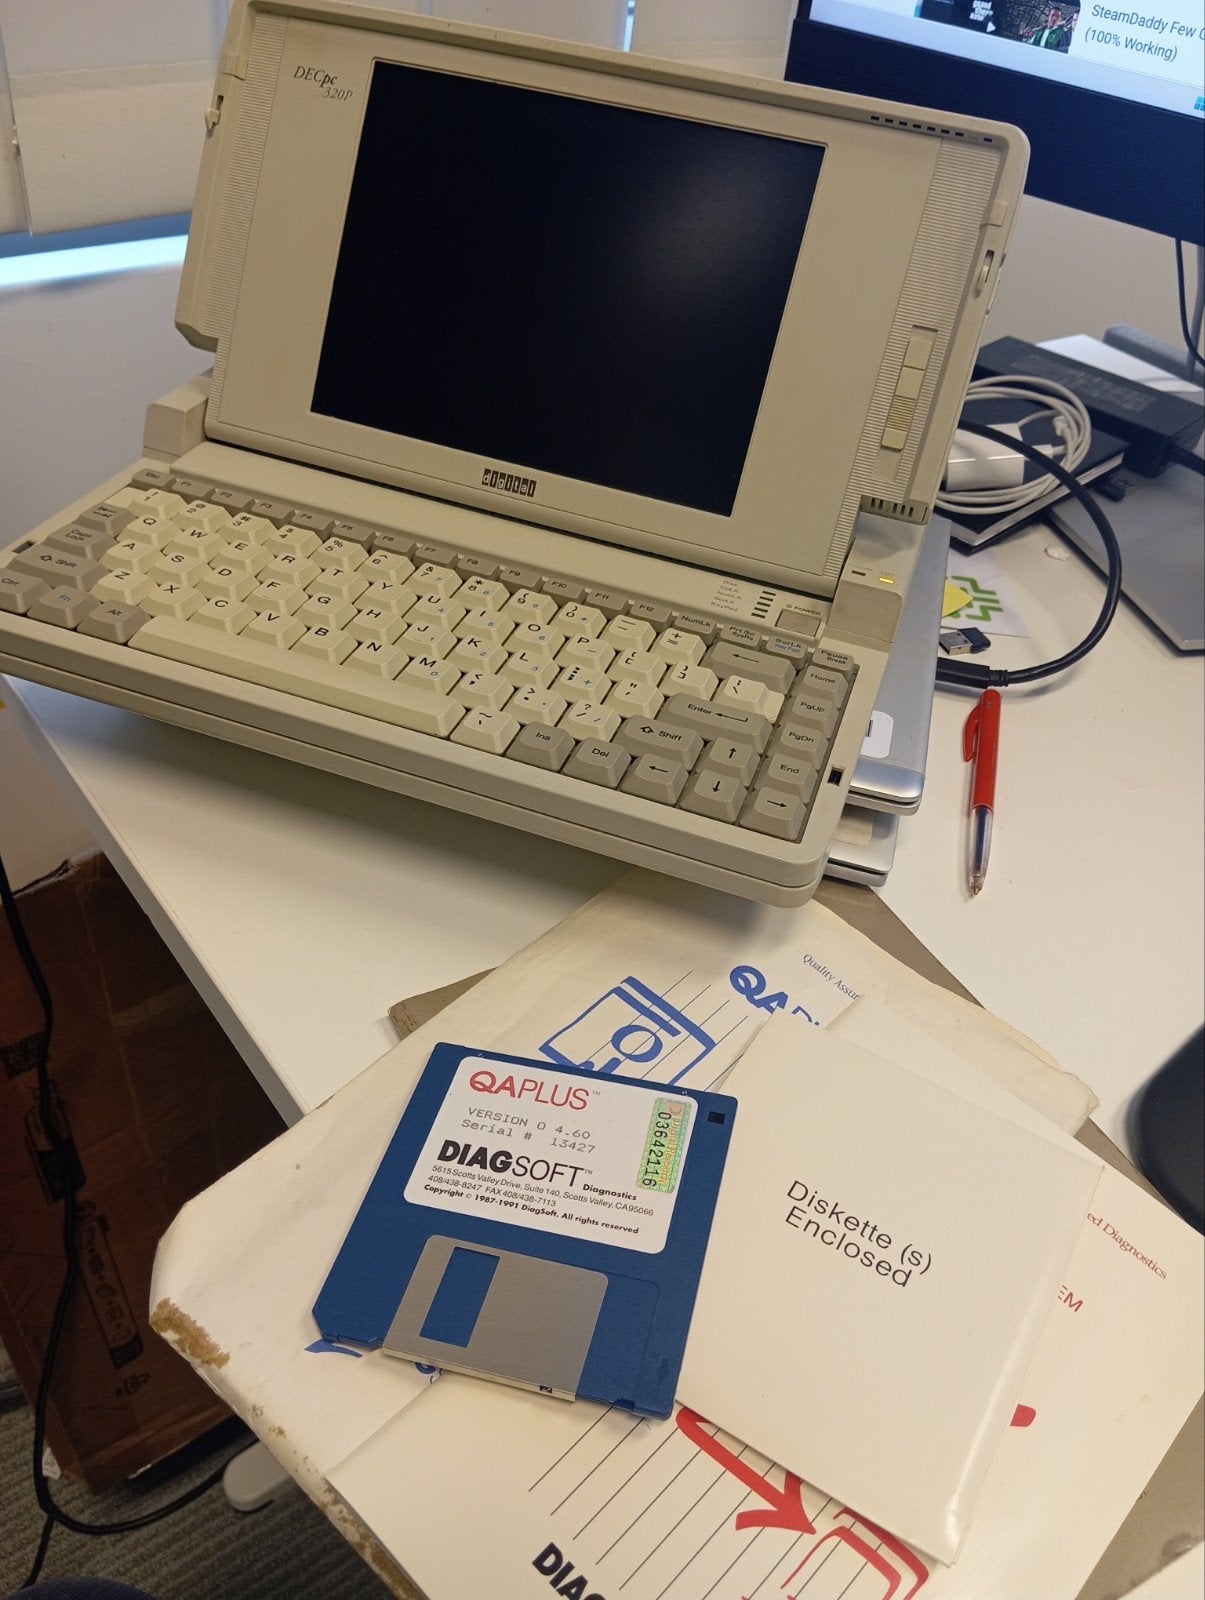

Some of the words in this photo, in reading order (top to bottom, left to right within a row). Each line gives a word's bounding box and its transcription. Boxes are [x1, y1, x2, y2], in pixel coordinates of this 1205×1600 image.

[1091, 4, 1169, 34] SteamDaddy
[1170, 21, 1197, 38] Few
[1085, 27, 1121, 47] (100%
[1124, 36, 1178, 62] Working)
[293, 65, 338, 88] DECpc
[322, 86, 353, 101] 320P
[482, 468, 538, 498] digital
[143, 517, 157, 526] Q
[190, 530, 208, 539] W
[122, 542, 136, 551] A
[234, 542, 248, 551] E
[55, 558, 78, 568] Shift
[171, 555, 185, 564] S
[281, 555, 296, 564] R
[114, 571, 130, 580] Z
[218, 568, 232, 577] D
[332, 568, 344, 576] T
[1, 577, 20, 587] Ctrl
[267, 581, 281, 590] F
[381, 582, 394, 590] Y
[552, 581, 568, 589] F10
[164, 584, 180, 594] X
[214, 600, 229, 608] C
[317, 596, 331, 605] G
[428, 596, 441, 604] U
[108, 608, 123, 616] Alt
[640, 604, 655, 612] F12
[267, 612, 280, 622] V
[366, 609, 382, 619] H
[314, 627, 329, 637] B
[417, 625, 429, 634] J
[528, 623, 541, 632] O
[468, 638, 482, 648] K
[577, 636, 590, 645] P
[366, 641, 382, 652] N
[519, 652, 529, 662] L
[418, 657, 438, 668] M
[810, 673, 836, 684] Home
[688, 704, 714, 716] Enter
[800, 702, 826, 714] PgUp
[536, 732, 550, 742] Ins
[658, 730, 682, 742] Shift
[788, 732, 815, 744] PgDn
[592, 748, 610, 758] Del
[780, 764, 800, 774] End
[803, 954, 835, 982] Quality
[469, 1070, 590, 1111] QAPLUS
[468, 1106, 529, 1127] VERSION
[555, 1125, 591, 1140] 4.60
[461, 1119, 513, 1138] Serial
[524, 1132, 533, 1141] #
[550, 1137, 596, 1154] 13427
[642, 1111, 672, 1187] 03642116
[437, 1139, 585, 1188] DIAGSOFT
[432, 1164, 452, 1175] 5615
[452, 1168, 476, 1180] Scotts
[478, 1174, 500, 1186] Valley
[524, 1183, 544, 1194] Suite
[562, 1192, 588, 1203] Scotts
[428, 1174, 483, 1192] 408/438-8247
[484, 1186, 502, 1196] FAX
[502, 1190, 557, 1208] 408/438-7113
[582, 1183, 637, 1201] Diagnostics
[424, 1184, 464, 1198] Copyright
[474, 1194, 518, 1210] 1987-1991
[521, 1204, 560, 1218] DiagSoft.
[561, 1212, 573, 1221] All
[574, 1215, 599, 1226] rights
[601, 1222, 640, 1234] reserved
[786, 1179, 894, 1252] Diskette
[899, 1241, 933, 1276] (s)
[785, 1205, 914, 1289] Enclosed
[1102, 1222, 1168, 1279] Diagnostics
[531, 1541, 607, 1600] DIA
